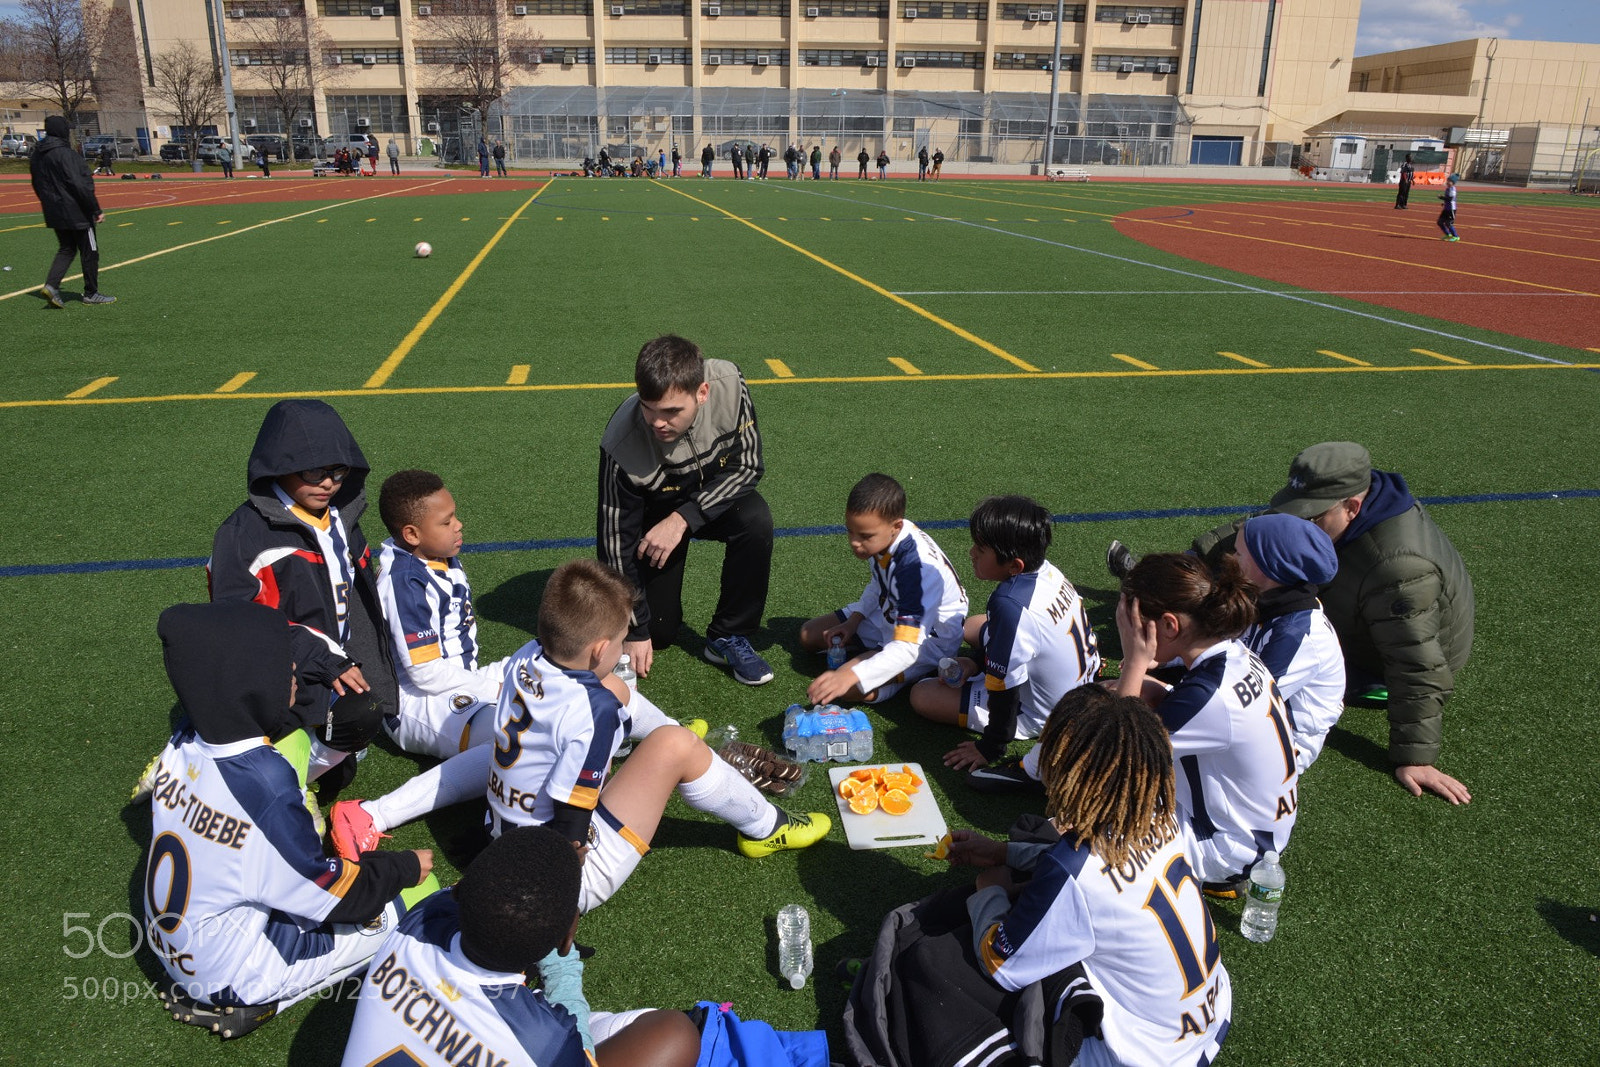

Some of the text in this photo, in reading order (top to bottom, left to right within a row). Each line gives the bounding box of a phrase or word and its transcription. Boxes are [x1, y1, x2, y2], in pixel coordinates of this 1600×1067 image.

[335, 581, 350, 622] 5
[494, 688, 534, 770] 3
[508, 786, 537, 814] FC
[147, 830, 192, 935] 0
